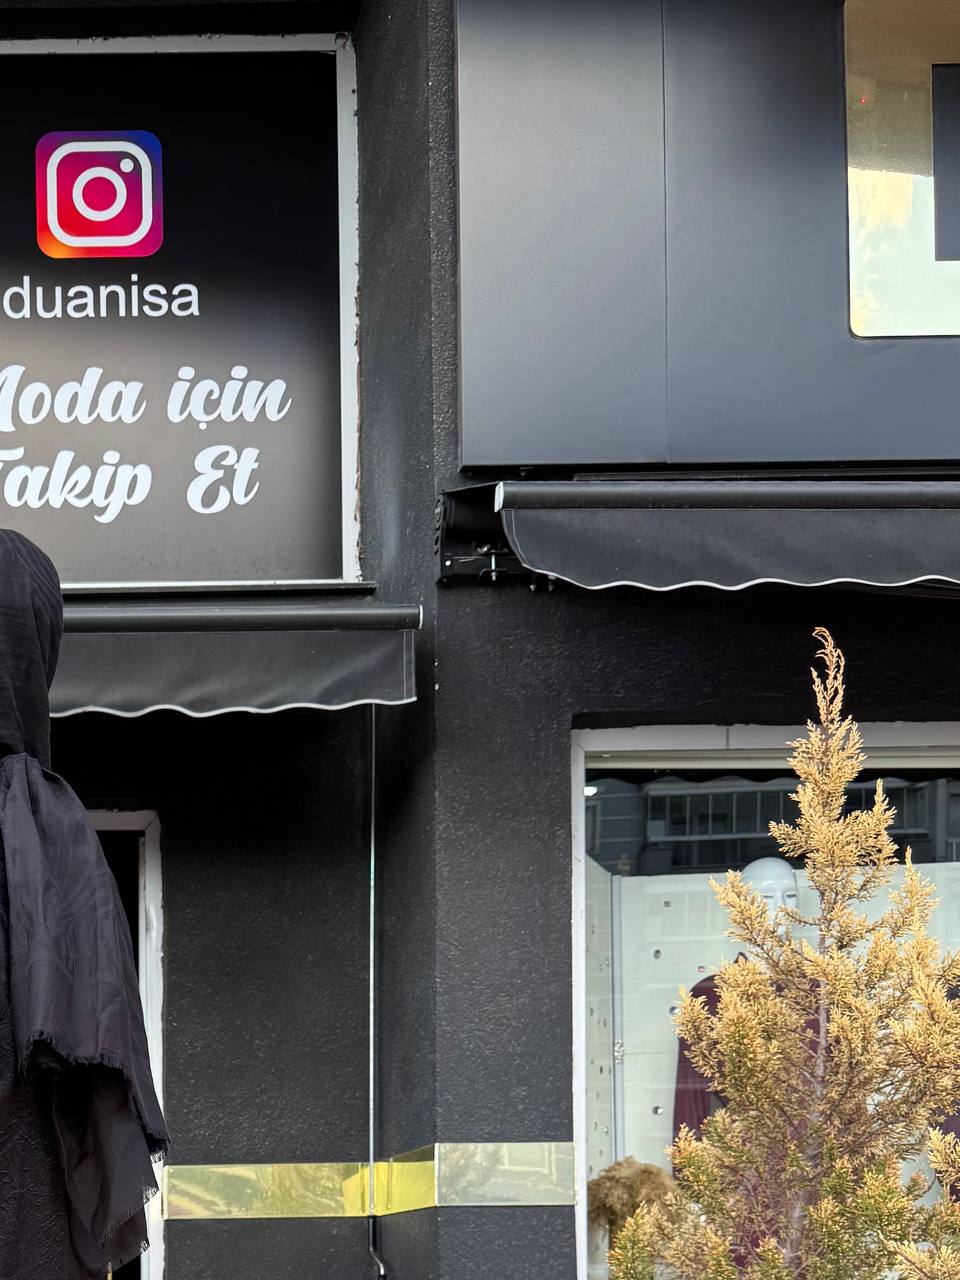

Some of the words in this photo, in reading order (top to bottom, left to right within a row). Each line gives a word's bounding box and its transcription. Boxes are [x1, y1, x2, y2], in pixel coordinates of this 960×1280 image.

[2, 274, 200, 319] duanisa
[166, 365, 292, 431] için
[186, 444, 260, 515] Et
